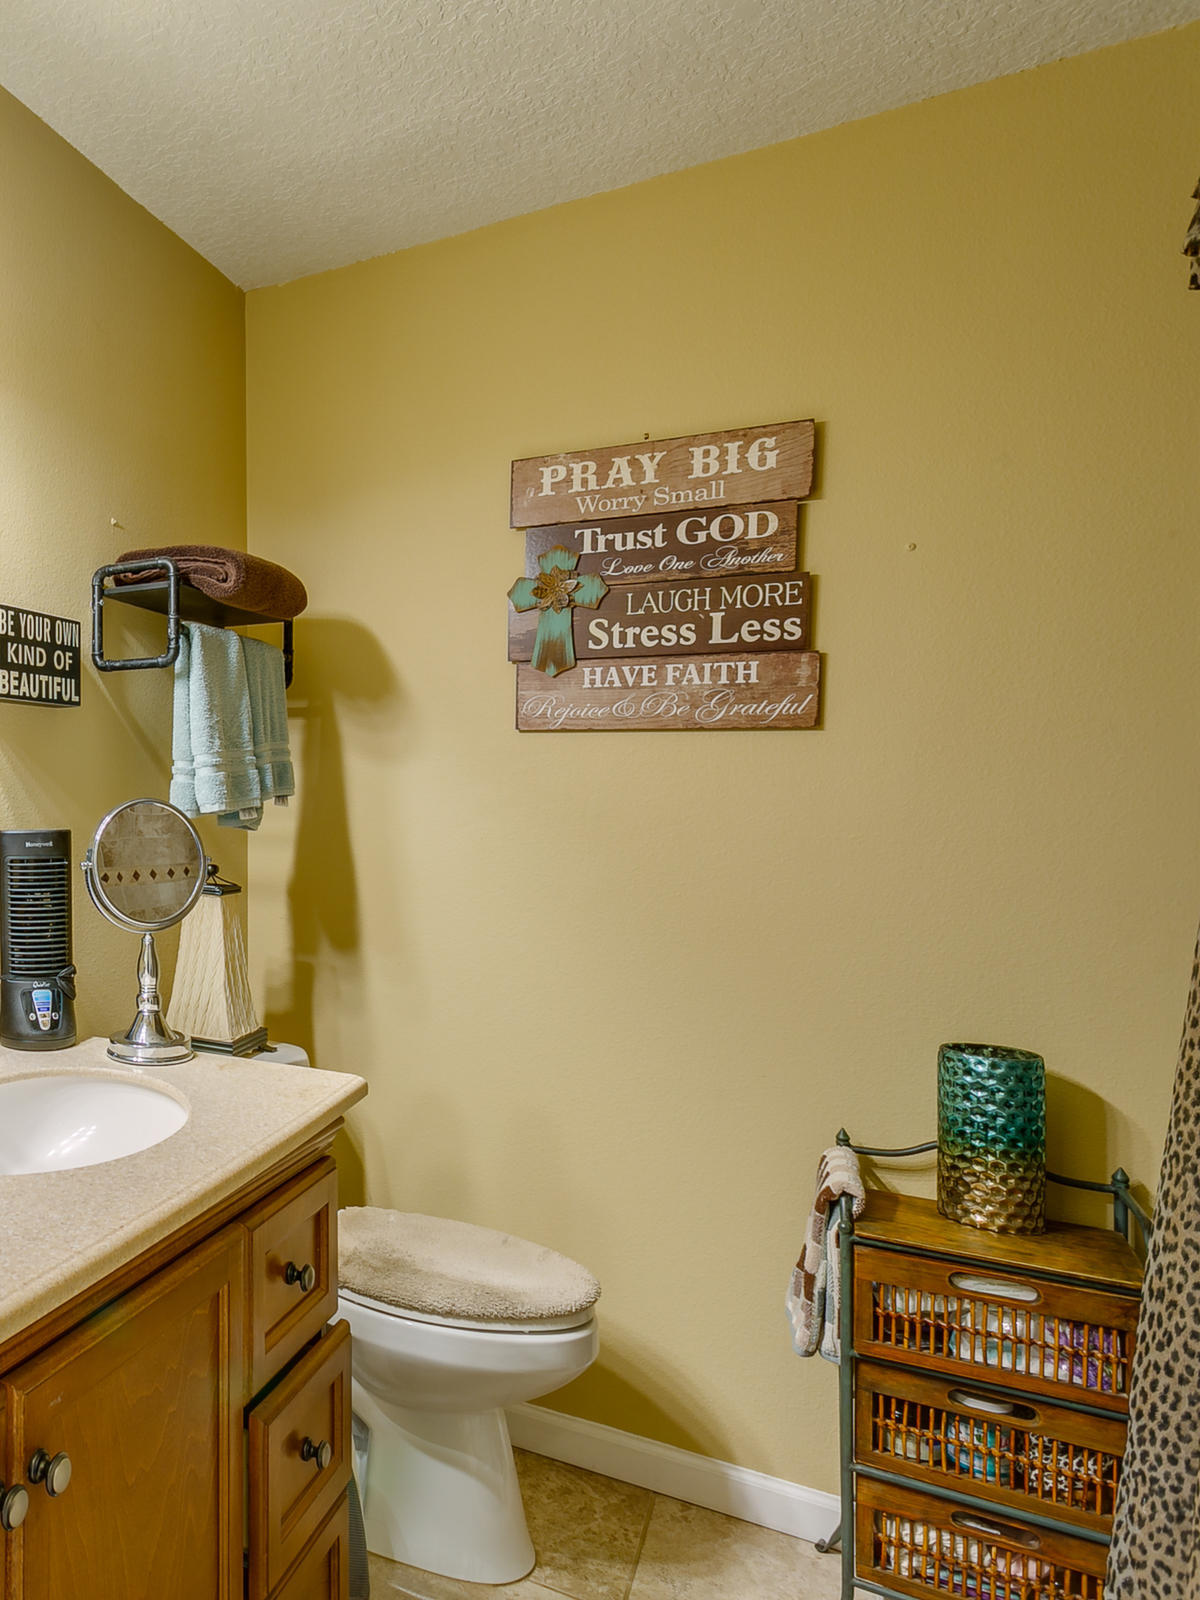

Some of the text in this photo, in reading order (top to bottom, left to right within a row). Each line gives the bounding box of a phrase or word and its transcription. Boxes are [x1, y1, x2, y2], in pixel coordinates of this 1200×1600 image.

[537, 436, 780, 497] PRAY BIG
[576, 480, 725, 514] Worry Small
[574, 510, 779, 554] Trust GOD
[600, 545, 786, 576] Love One Another
[626, 581, 803, 616] LAUGH MORE
[0, 608, 79, 648] BE YOUR OWN
[588, 611, 802, 650] Stress Less
[7, 642, 73, 671] KIND OF
[0, 669, 80, 702] BEAUTIFUL
[582, 661, 760, 689] HAVE FAITH
[522, 688, 814, 729] Rejoice & Be Grateful
